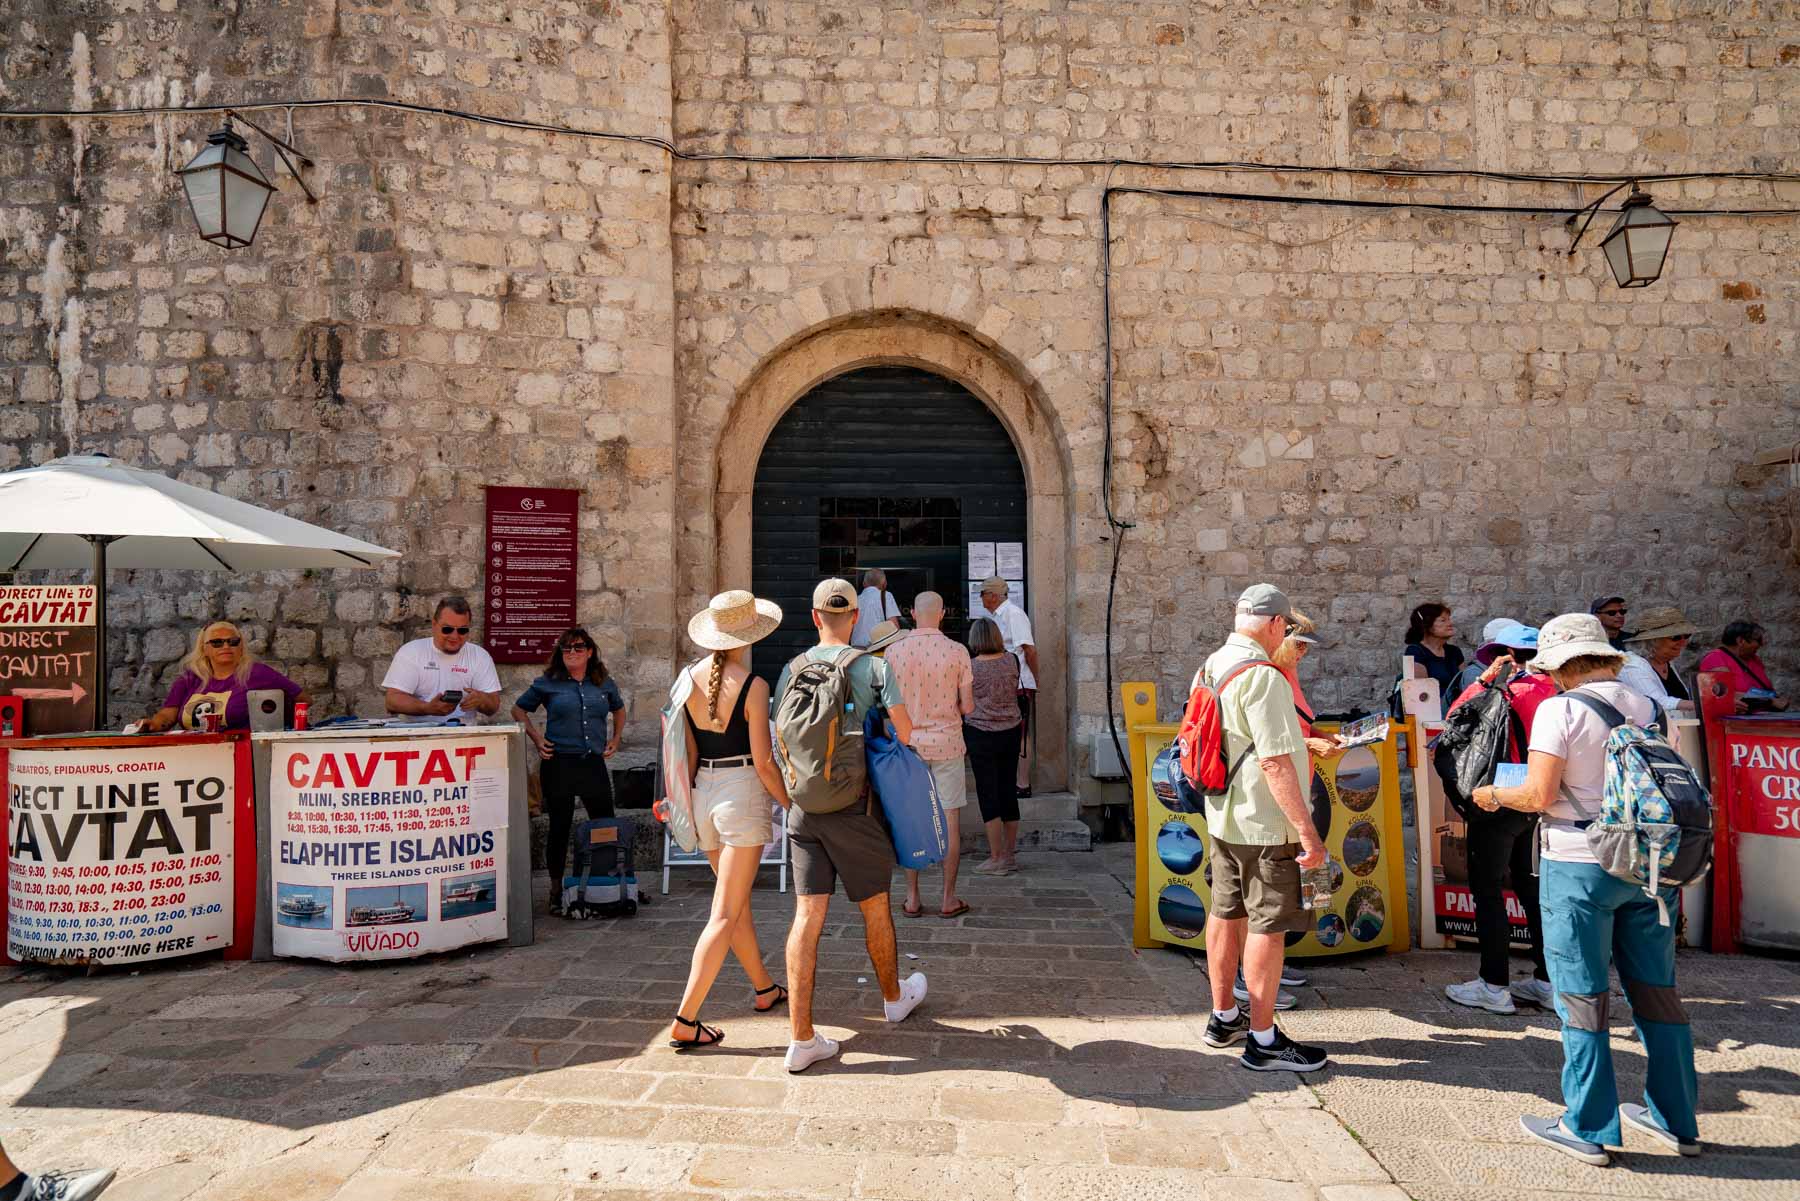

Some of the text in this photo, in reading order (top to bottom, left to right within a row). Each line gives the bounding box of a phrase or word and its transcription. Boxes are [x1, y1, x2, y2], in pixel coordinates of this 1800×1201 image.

[0, 588, 43, 600] DIRECT
[78, 588, 93, 600] TO
[0, 601, 93, 624] CAVTAT
[0, 631, 70, 649] DIRECT
[54, 764, 113, 776] EPIDAURUS,
[116, 762, 166, 773] CROATIA
[287, 747, 486, 789] CAVTAT
[9, 777, 225, 811] IRECT LINE TO
[298, 792, 337, 809] MLINI,
[342, 789, 428, 807] SREBRENO,
[433, 786, 468, 802] PLAT
[330, 812, 357, 823] 10:30,
[360, 811, 389, 823] 11:00,
[392, 809, 422, 821] 11:30,
[425, 806, 454, 819] 12:00,
[334, 824, 361, 835] 16:30,
[364, 823, 394, 834] 17:45,
[396, 821, 426, 832] 19:00,
[428, 818, 458, 830] 20:15,
[280, 830, 494, 866] ELAPHITE ISLANDS
[52, 867, 75, 879] 9:45,
[79, 866, 110, 878] 10:00,
[114, 863, 147, 876] 10:15,
[151, 858, 186, 874] 10:30,
[190, 854, 222, 869] 11:00,
[331, 857, 495, 881] THREE ISLANDS CRUISE 10:45
[45, 884, 72, 898] 13:00,
[75, 882, 107, 897] 14:00,
[111, 880, 145, 894] 14:30,
[149, 876, 185, 890] 15:00,
[188, 871, 222, 886] 15:30,
[1167, 878, 1193, 889] BEACH
[25, 900, 46, 914] 17:00,
[49, 902, 75, 915] 17:30,
[78, 901, 109, 913] 18:3,
[112, 898, 147, 911] 21:00,
[150, 892, 185, 907] 23:00
[57, 919, 81, 930] 10:10,
[85, 917, 115, 928] 10:30,
[119, 914, 150, 926] 11:00,
[154, 909, 187, 922] 12:00,
[191, 904, 223, 918] 13:00,
[45, 932, 69, 944] 16:30,
[72, 932, 99, 944] 17:30,
[103, 928, 136, 942] 19:00,
[140, 924, 173, 937] 20:00
[156, 935, 195, 953] HERE
